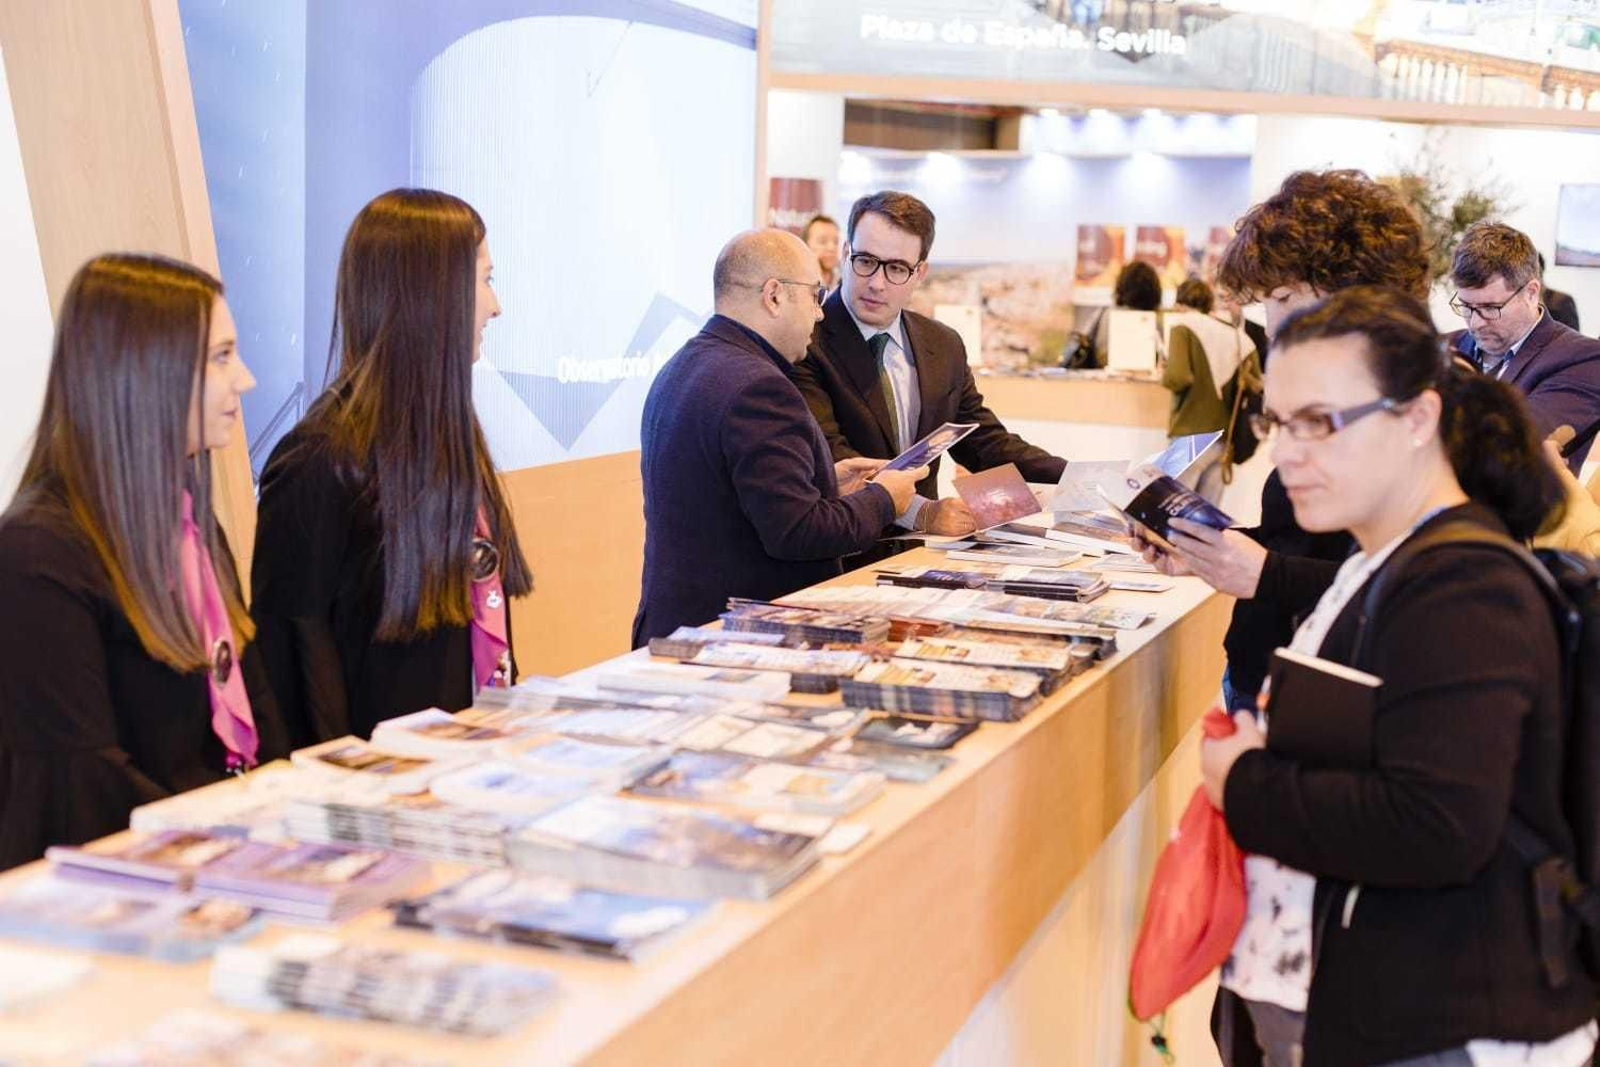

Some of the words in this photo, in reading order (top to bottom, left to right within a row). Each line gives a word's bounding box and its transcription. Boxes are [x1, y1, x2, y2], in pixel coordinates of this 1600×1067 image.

[861, 14, 934, 42] Plaza
[941, 18, 977, 44] de
[1097, 26, 1187, 55] Sevilla
